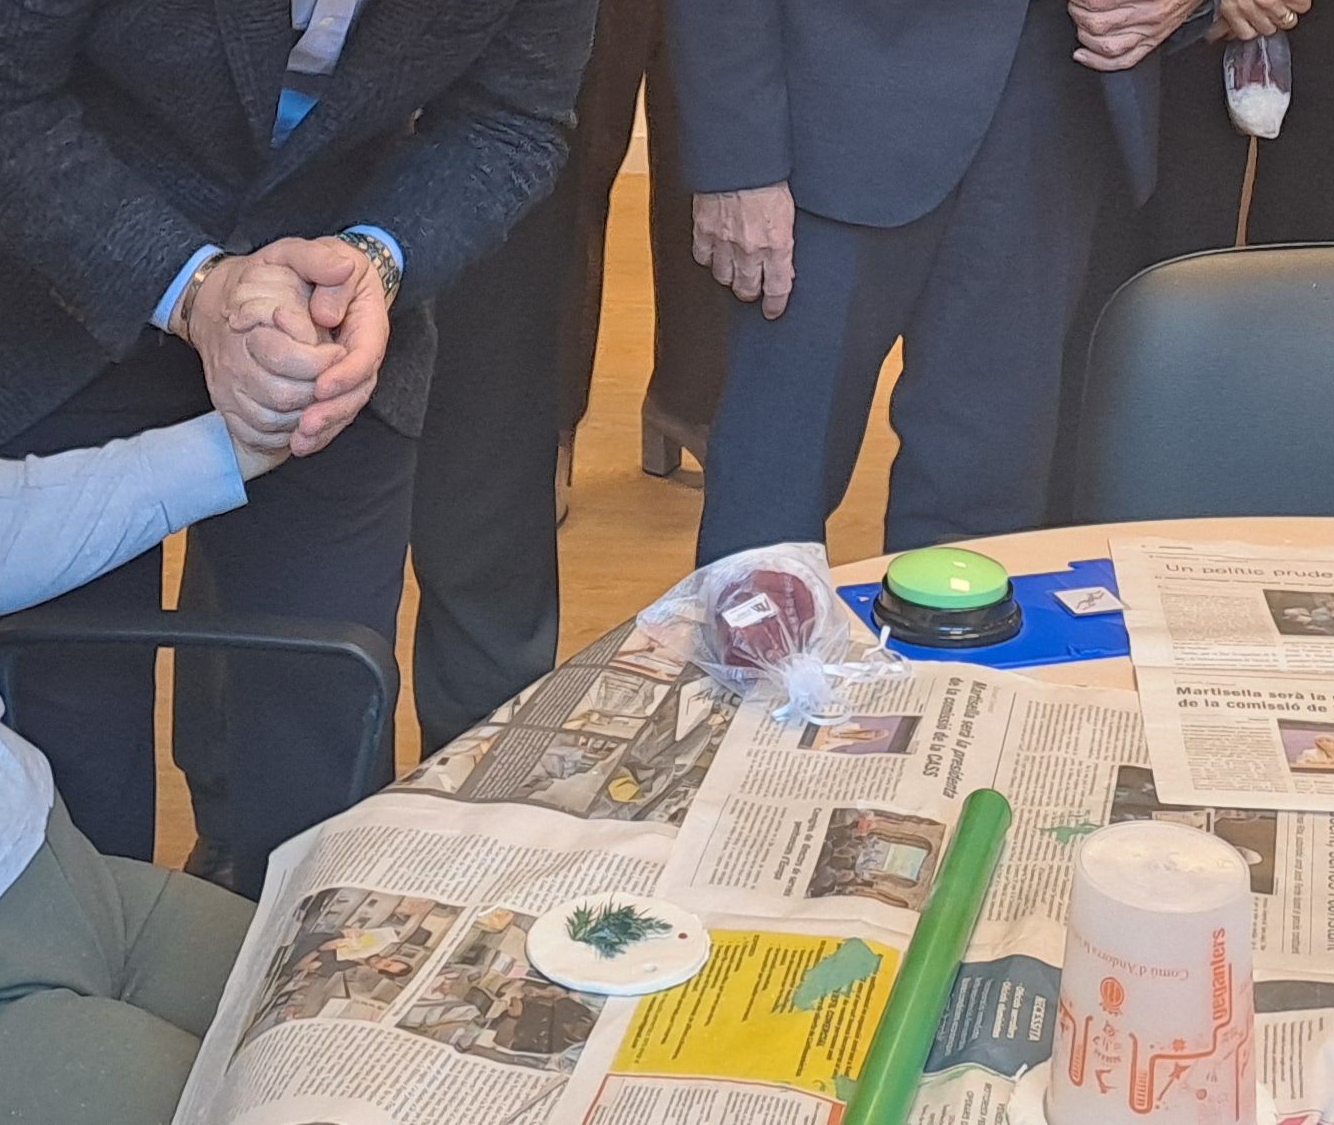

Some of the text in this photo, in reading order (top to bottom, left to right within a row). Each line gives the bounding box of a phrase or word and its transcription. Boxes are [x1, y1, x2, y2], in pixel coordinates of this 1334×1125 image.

[1165, 563, 1193, 574] Un
[948, 677, 963, 686] de
[946, 687, 961, 696] la
[1176, 686, 1262, 699] Martisella
[1269, 689, 1304, 701] serà
[1310, 692, 1326, 702] la
[1178, 698, 1198, 708] de
[1205, 699, 1219, 709] la
[1226, 701, 1300, 712] comissió
[1307, 703, 1327, 713] de
[932, 731, 949, 742] de
[929, 743, 946, 752] la
[955, 738, 972, 749] la
[923, 753, 943, 778] CASS
[942, 747, 965, 799] presidenta
[1210, 927, 1228, 1020] geganters
